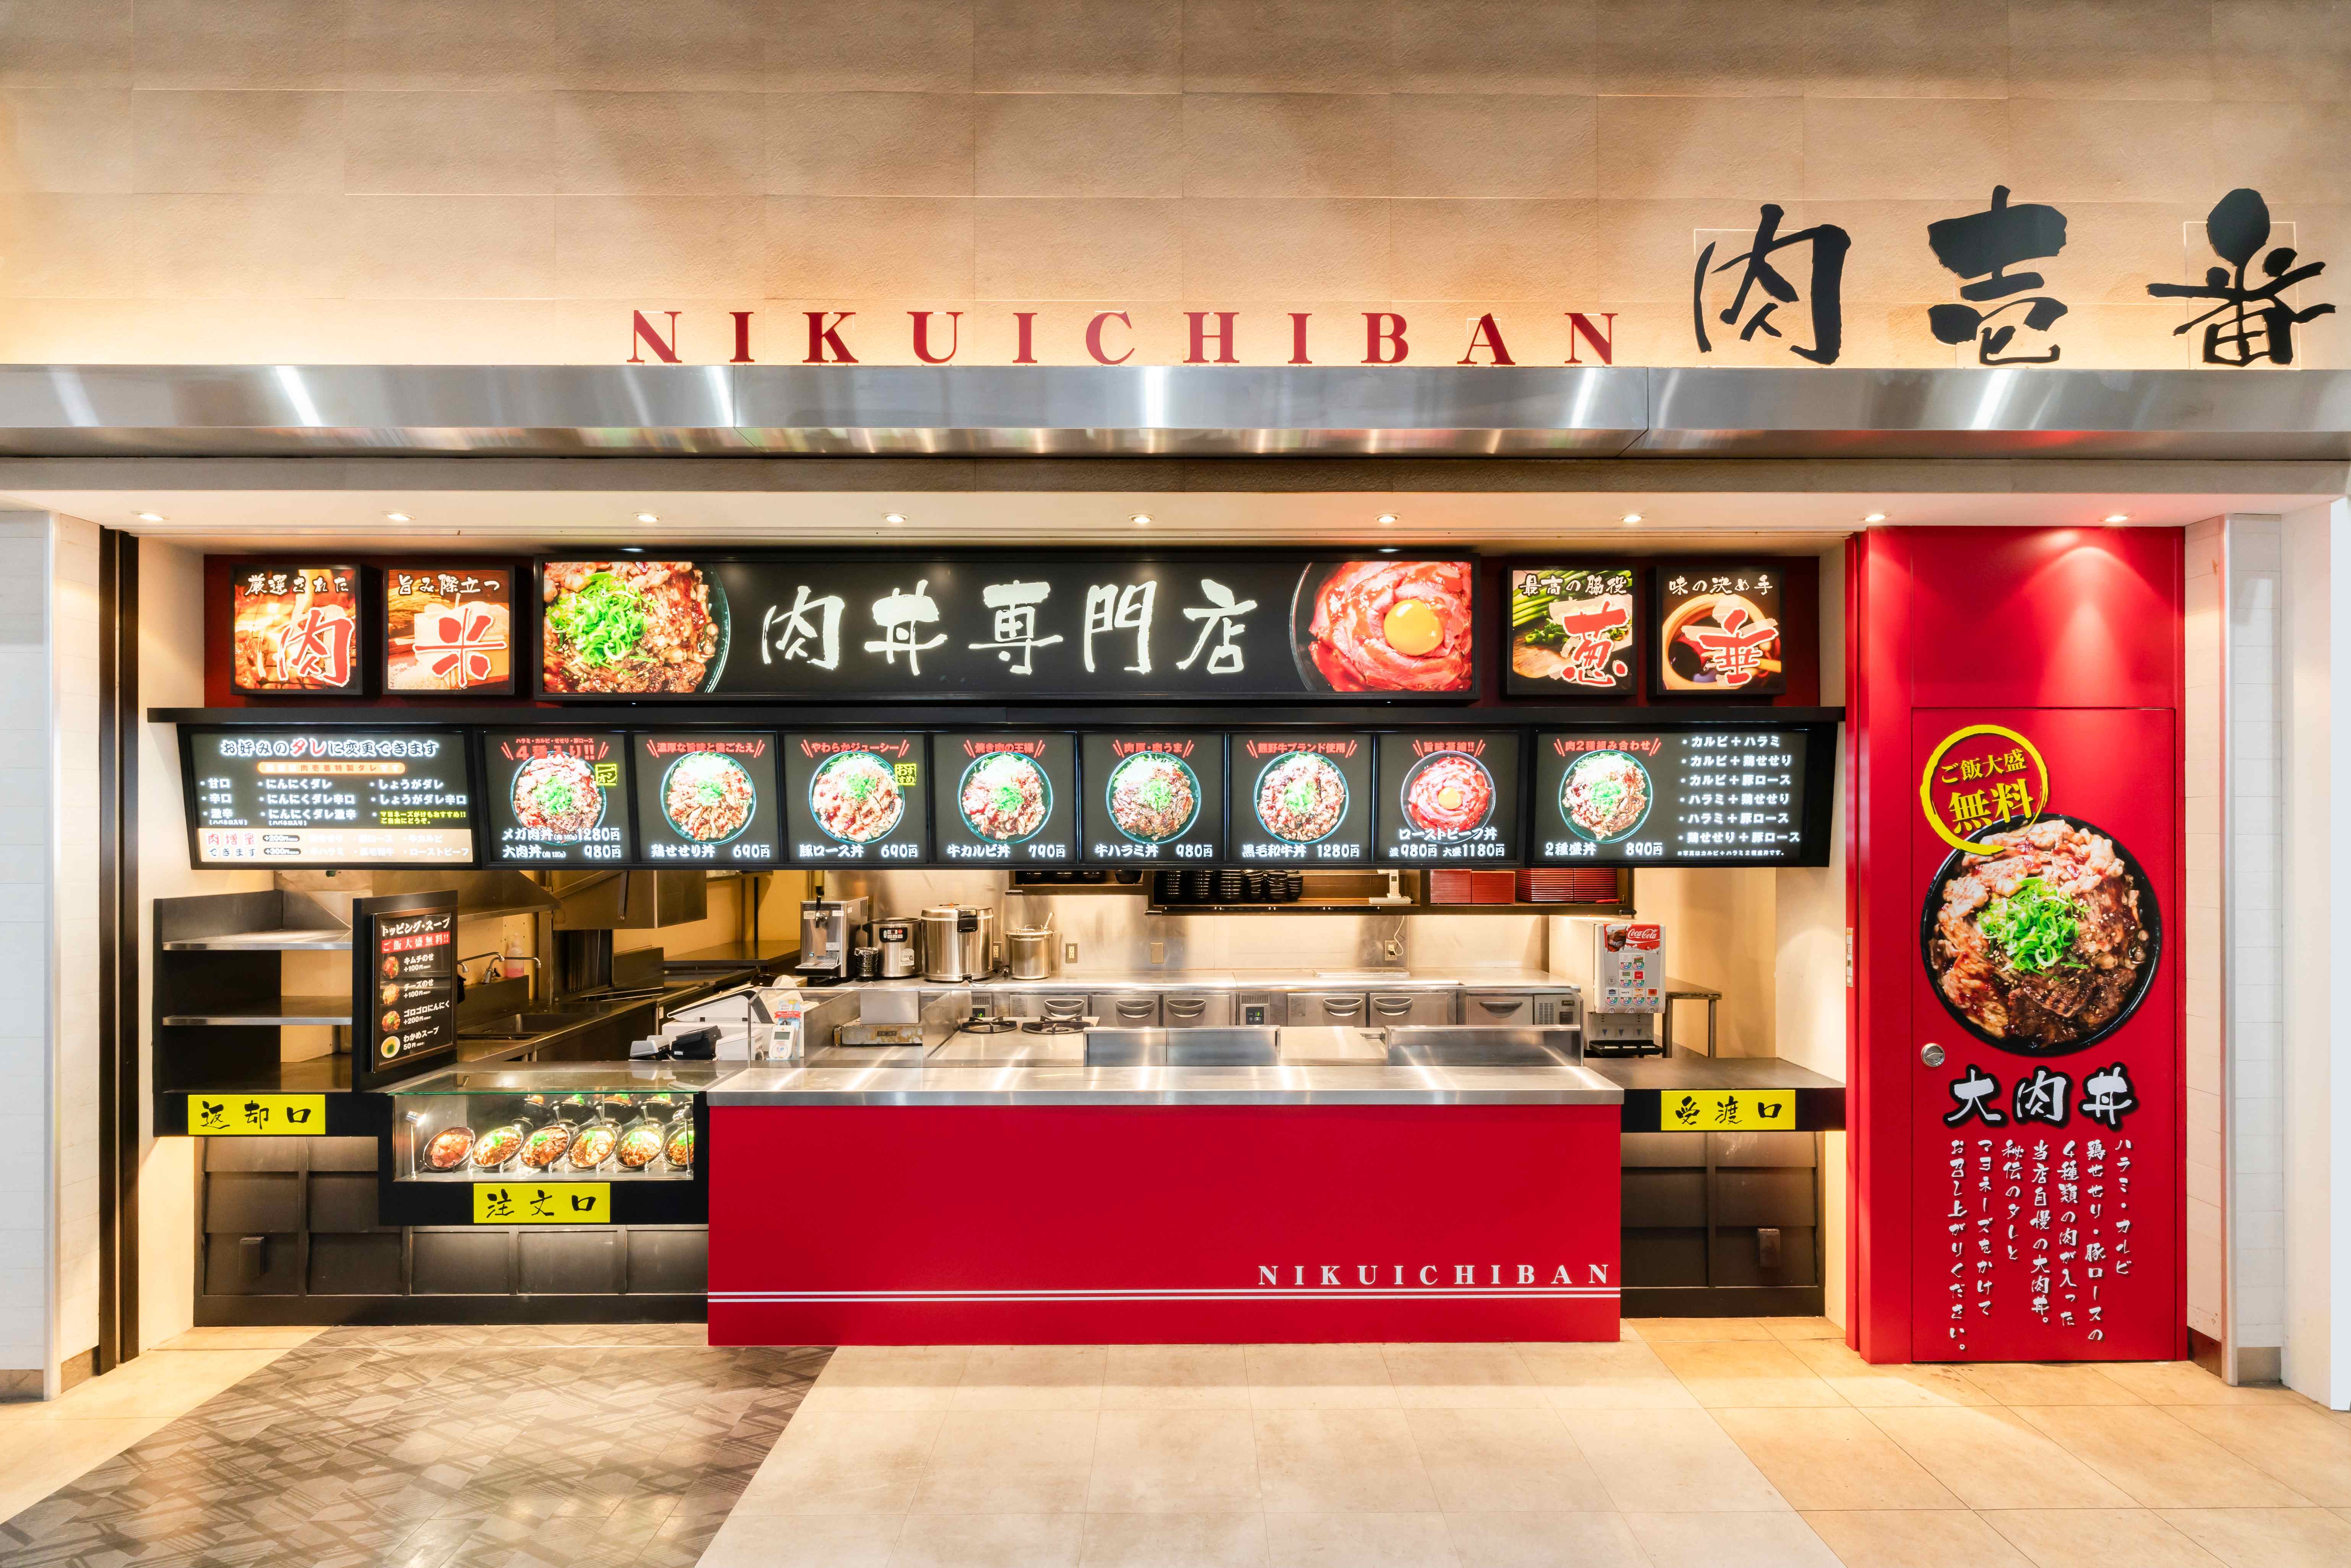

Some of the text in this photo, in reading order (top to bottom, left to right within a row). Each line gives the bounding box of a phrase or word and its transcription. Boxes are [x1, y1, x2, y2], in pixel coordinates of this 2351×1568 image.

[1695, 185, 2336, 365] 肉壱番
[629, 310, 1617, 365] NIKUICHIBAN
[244, 574, 350, 596] 厳選された
[398, 574, 502, 596] 旨み際立つ
[1519, 575, 1627, 596] 最高の脇役
[1669, 575, 1774, 596] 味の決め手
[762, 579, 1257, 676] 肉丼専門店
[278, 608, 354, 687] 肉
[412, 607, 507, 687] 米
[221, 738, 440, 758] お好みのタレに変更できます
[811, 743, 900, 754] やわらかジューシー
[1125, 743, 1182, 753] 肉厚・肉うま
[1566, 741, 1652, 751] 肉2種組み合わせ
[1692, 736, 1779, 747] カルビ+ハラミ
[1941, 748, 2027, 783] ご飯大盛
[208, 778, 444, 790] 甘口 にんにくダレ しょうがダレ
[1690, 775, 1790, 786] カルビ+豚ロース
[210, 794, 466, 805] 辛口 にんにくダレ辛口 しょうがダレ辛口
[1948, 778, 2034, 834] 無料
[1688, 813, 1789, 824] ハラミ+豚ロース
[208, 833, 256, 845] 肉増量
[501, 827, 553, 840] メガ肉丼
[577, 827, 619, 841] 1280円
[1399, 827, 1498, 840] ローストビーフ丼
[209, 848, 255, 857] できます
[409, 848, 470, 856] ローストビーフ
[504, 845, 543, 858] 大肉丼
[585, 845, 621, 858] 980円
[652, 843, 770, 858] 鶏せせり丼 690円
[800, 844, 918, 857] 豚ロース丼 690円
[948, 844, 1065, 858] 牛カルビ丼 790円
[1095, 842, 1212, 857] 牛ハラミ丼 980円
[1243, 844, 1359, 858] 黒毛和牛丼 1280円
[1390, 844, 1505, 857] 並 980円 大盛 1180円
[1546, 842, 1663, 856] 2種盛丼 890円
[382, 917, 450, 937] トッピング・スープ
[383, 933, 448, 951] ご飯大盛無料!!
[404, 953, 434, 965] キムチのせ
[404, 964, 423, 972] +100円
[404, 979, 434, 991] チーズのせ
[404, 990, 423, 998] +100円
[404, 1000, 449, 1017] ゴロゴロにんにく
[403, 1016, 423, 1025] +200円
[403, 1026, 439, 1043] わかめスープ
[1947, 1066, 2132, 1125] 大肉丼
[201, 1100, 311, 1129] 返却口
[1675, 1095, 1782, 1125] 受渡口
[486, 1189, 596, 1218] 注文口
[2002, 1139, 2024, 1260] 秘伝のタレと
[2115, 1139, 2132, 1274] ハラミ・カルビ
[1977, 1139, 1993, 1315] マヨネーズをかけて
[2030, 1139, 2051, 1323] 当店自慢の大肉丼。
[2057, 1140, 2079, 1326] 4種類の肉が入った
[1948, 1139, 1968, 1350] お召し上がりください。
[2085, 1139, 2106, 1341] 鶏せせり・豚ロースの
[1258, 1264, 1608, 1285] NIKUICHIBAN
